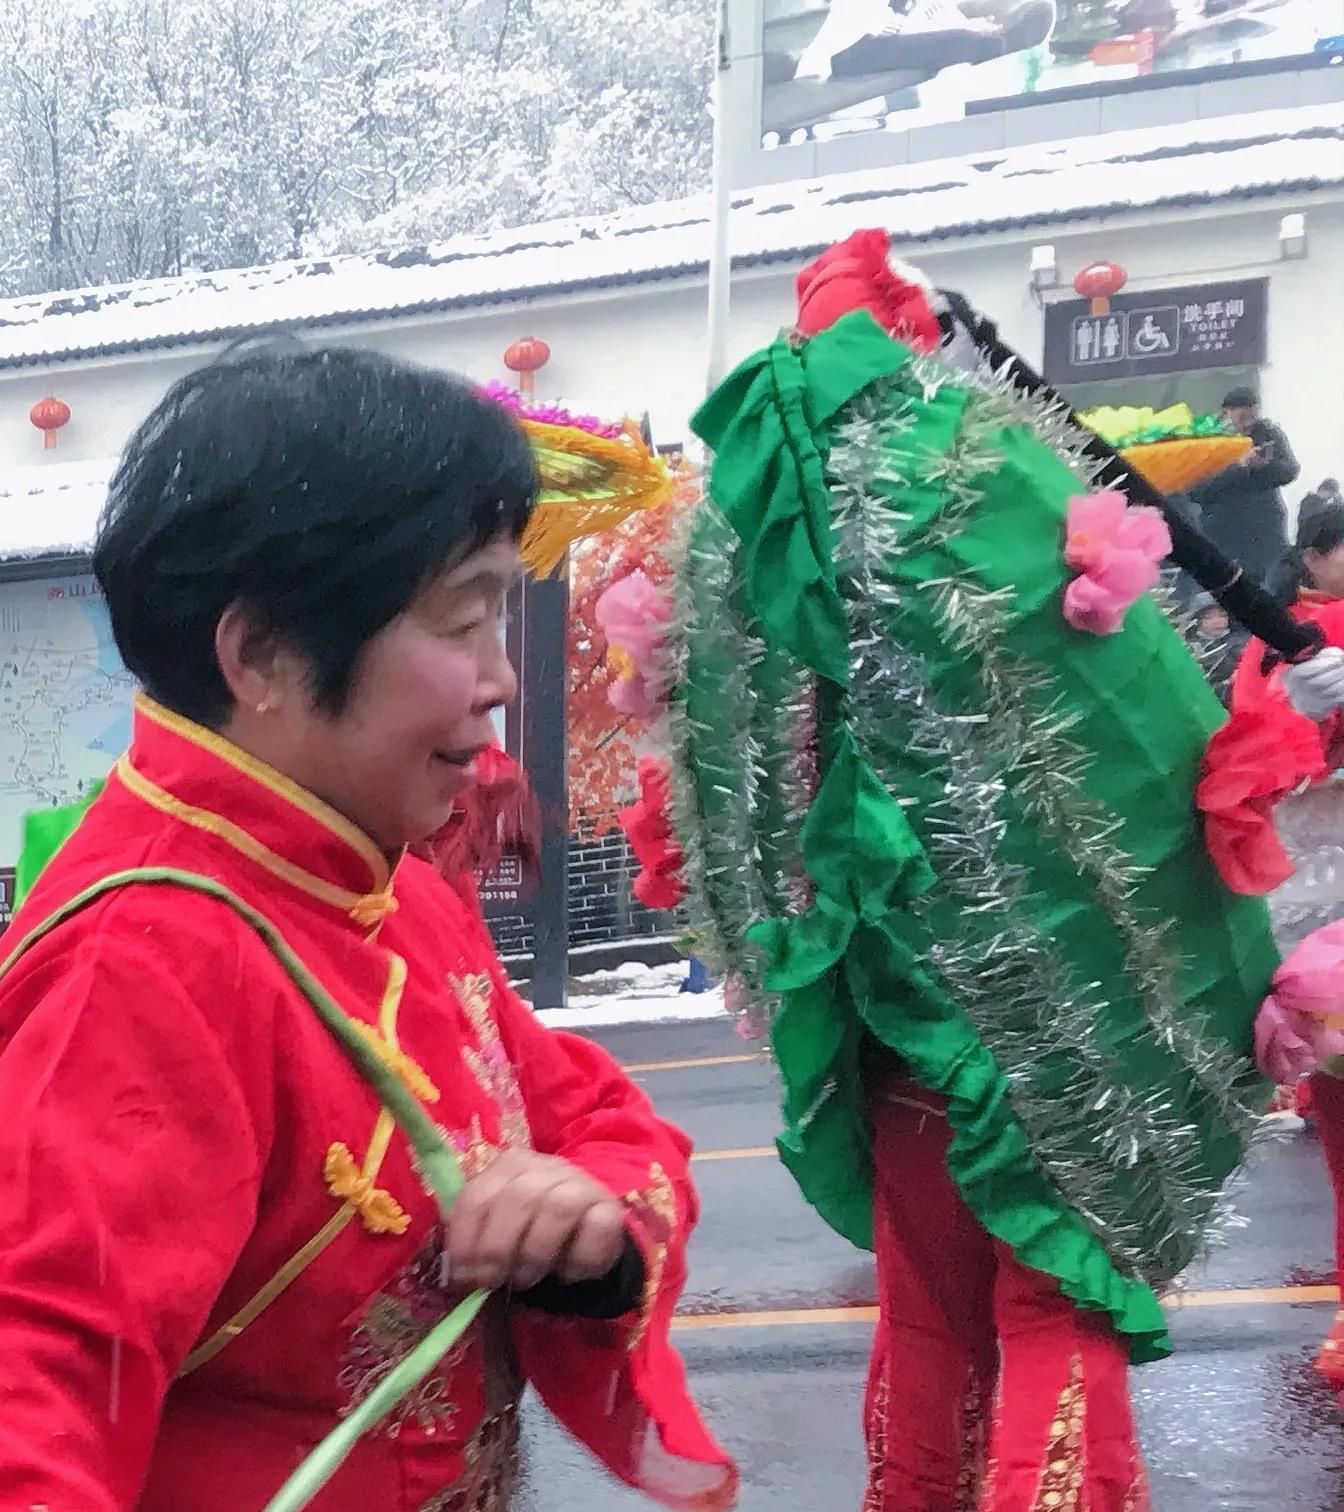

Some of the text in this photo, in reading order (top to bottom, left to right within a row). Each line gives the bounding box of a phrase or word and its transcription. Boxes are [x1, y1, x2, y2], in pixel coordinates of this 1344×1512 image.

[1184, 299, 1244, 322] 洗手间
[1189, 319, 1237, 332] TOILET
